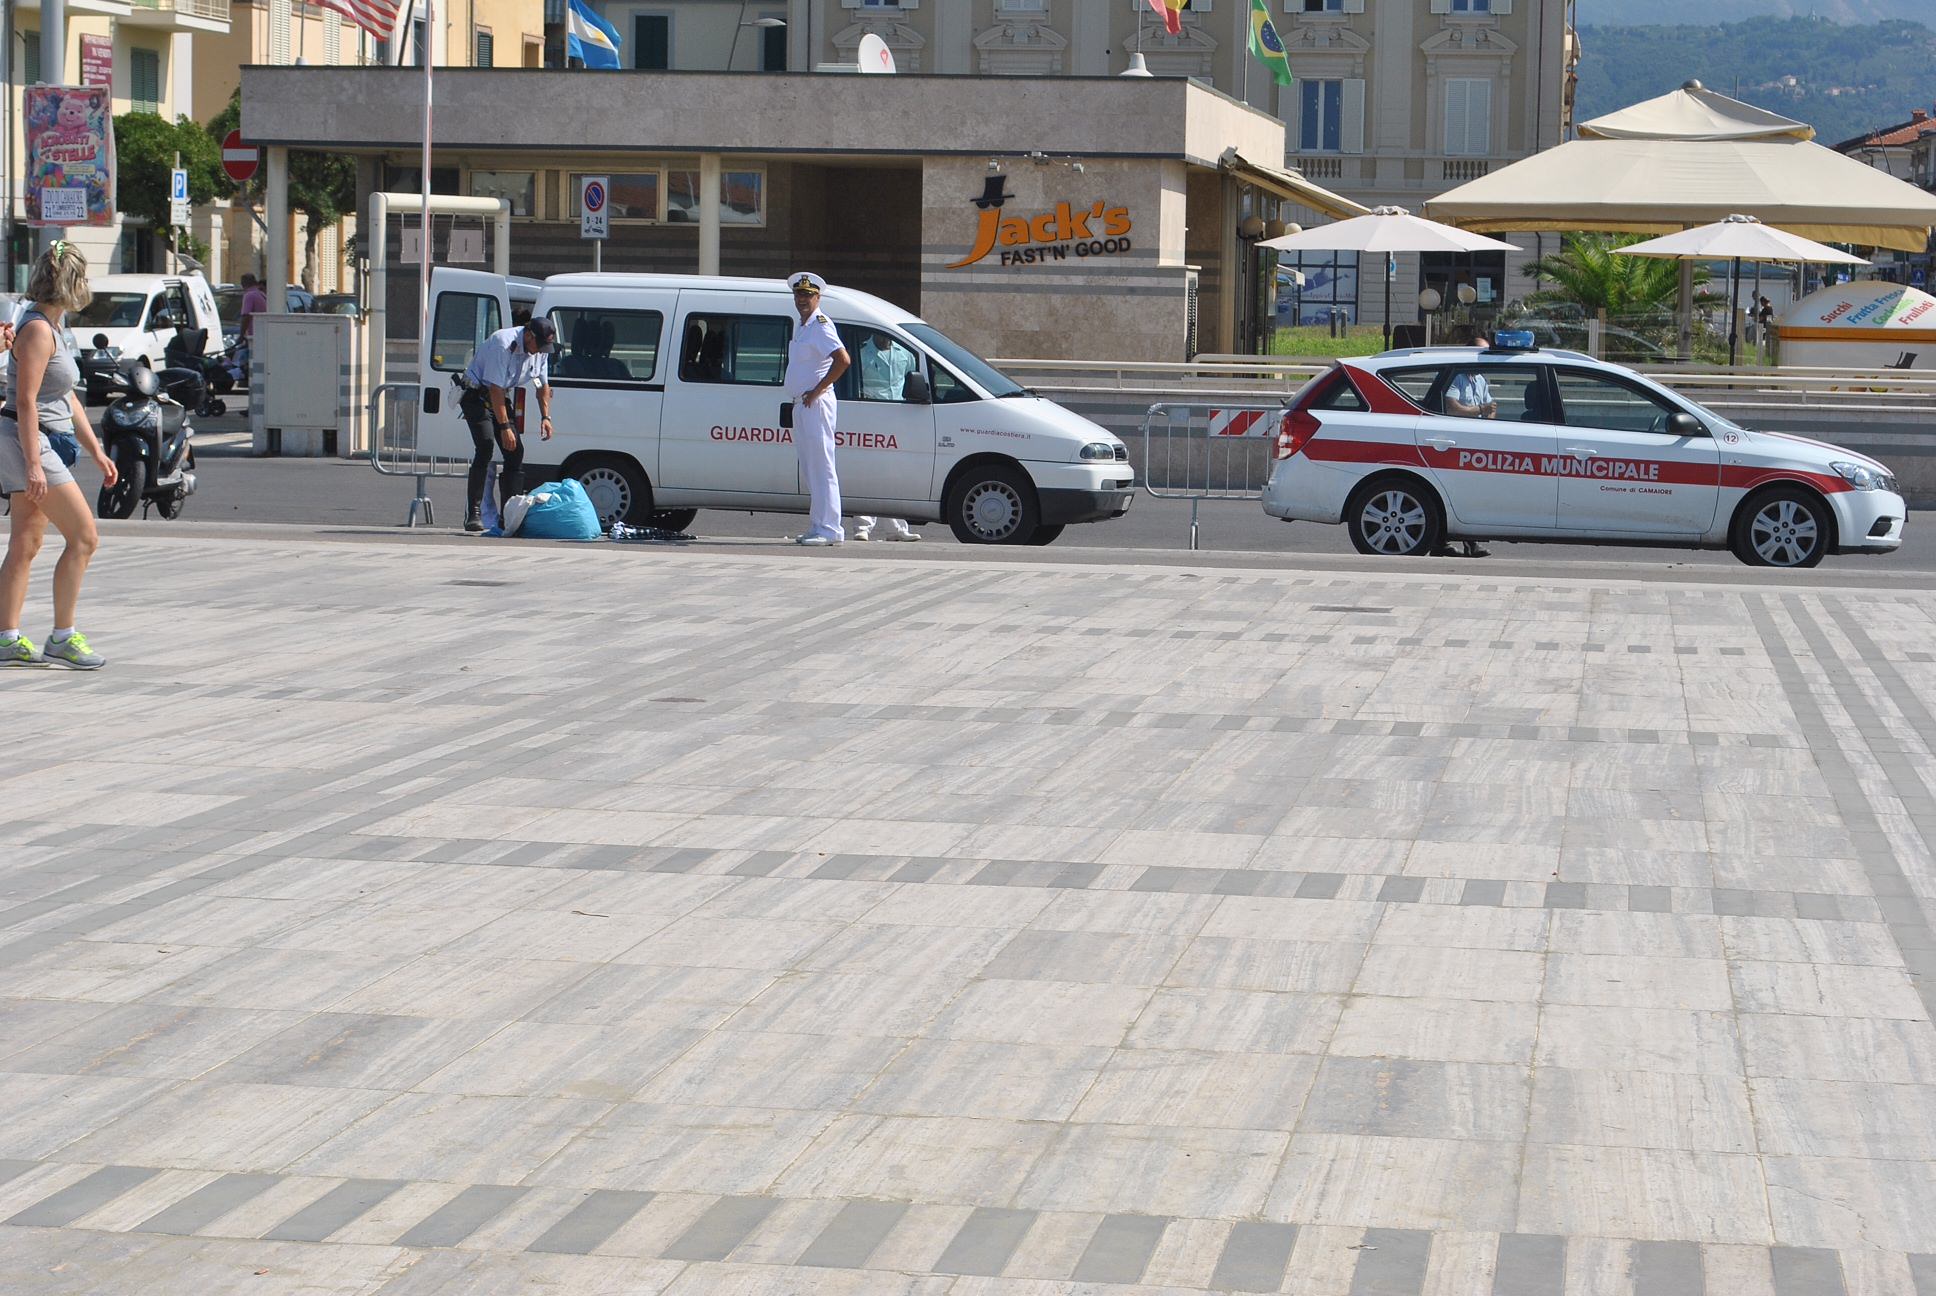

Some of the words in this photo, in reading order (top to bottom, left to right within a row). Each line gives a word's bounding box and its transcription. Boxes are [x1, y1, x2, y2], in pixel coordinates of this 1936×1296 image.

[1076, 237, 1131, 257] GOOD
[1820, 301, 1853, 324] Succhi
[1847, 304, 1879, 325] Frutta
[1899, 300, 1935, 325] Frullati
[710, 425, 793, 443] GUARDIA
[835, 431, 898, 449] STIERA
[960, 428, 1031, 440] www.guardiacostiera.it
[1726, 435, 1737, 443] 12
[1540, 457, 1660, 480] MUNICIPALE
[1600, 485, 1627, 493] Comune
[1638, 487, 1673, 495] CAMAIORE
